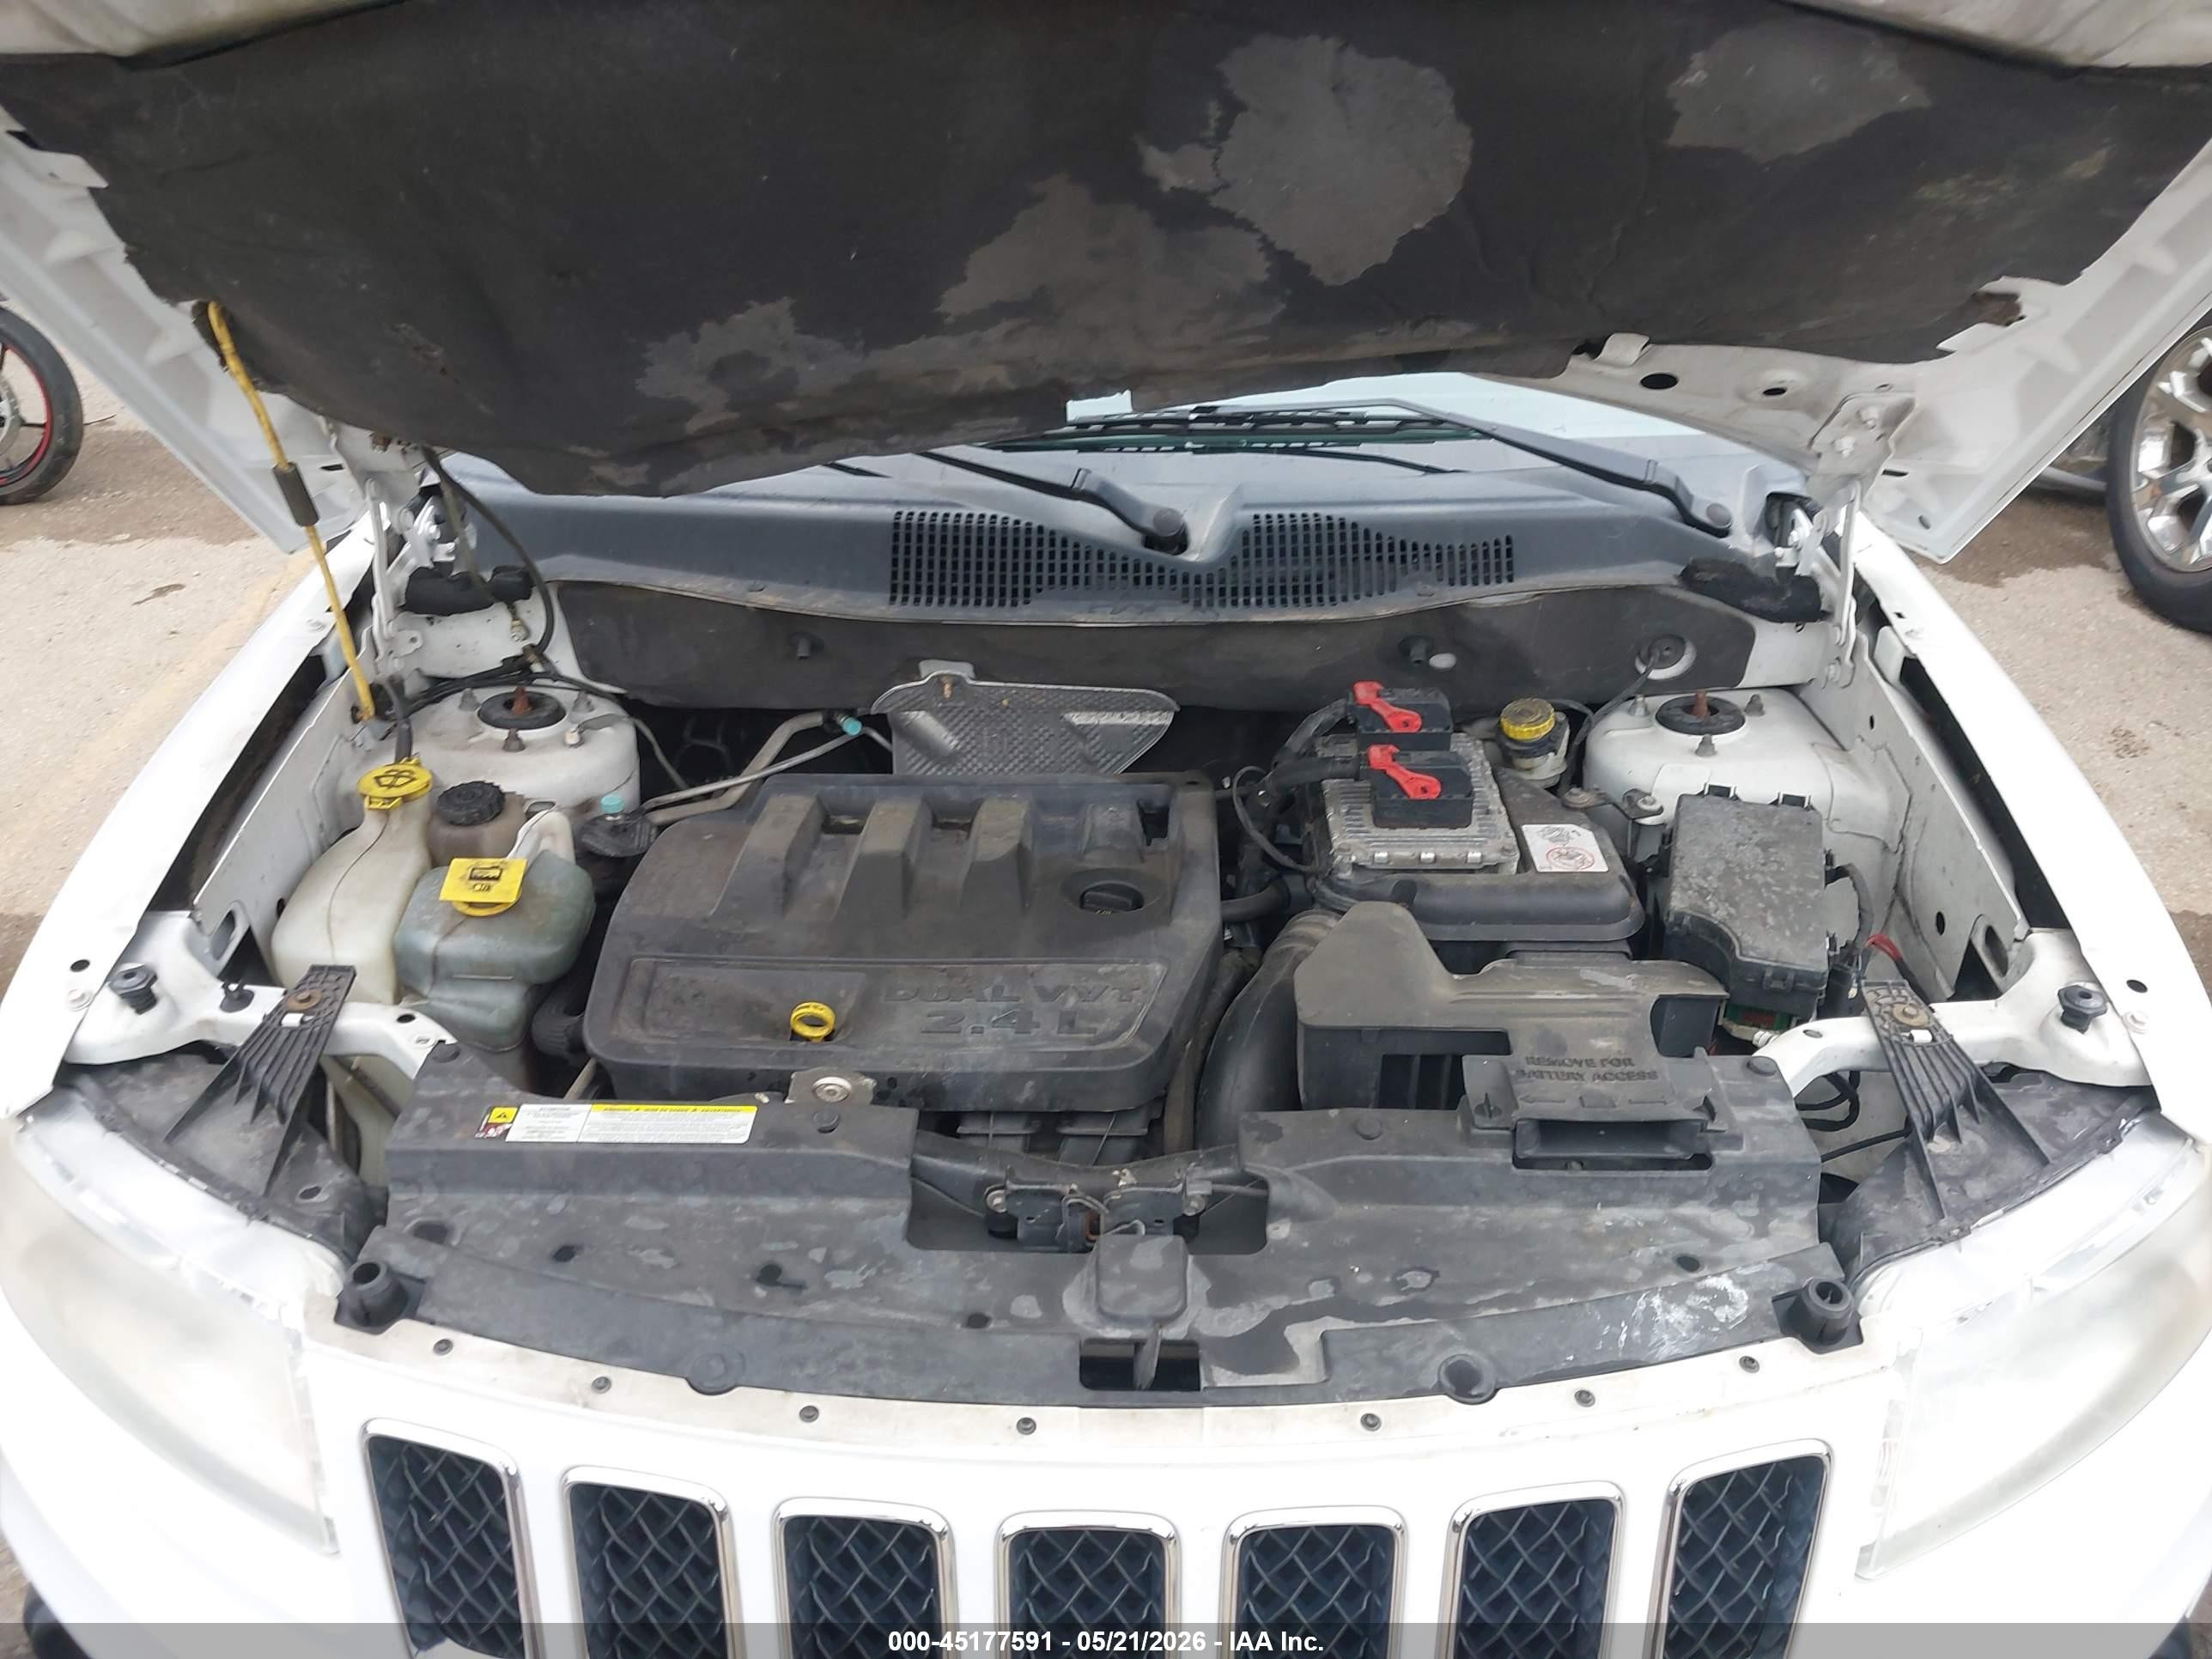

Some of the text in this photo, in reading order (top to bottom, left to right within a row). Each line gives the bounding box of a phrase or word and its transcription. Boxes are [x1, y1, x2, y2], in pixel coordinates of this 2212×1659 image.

[884, 985, 1141, 1003] DUAL VVT
[1525, 1056, 1635, 1068] REMOVE FOR
[1516, 1069, 1659, 1082] BATTERY ACCESS
